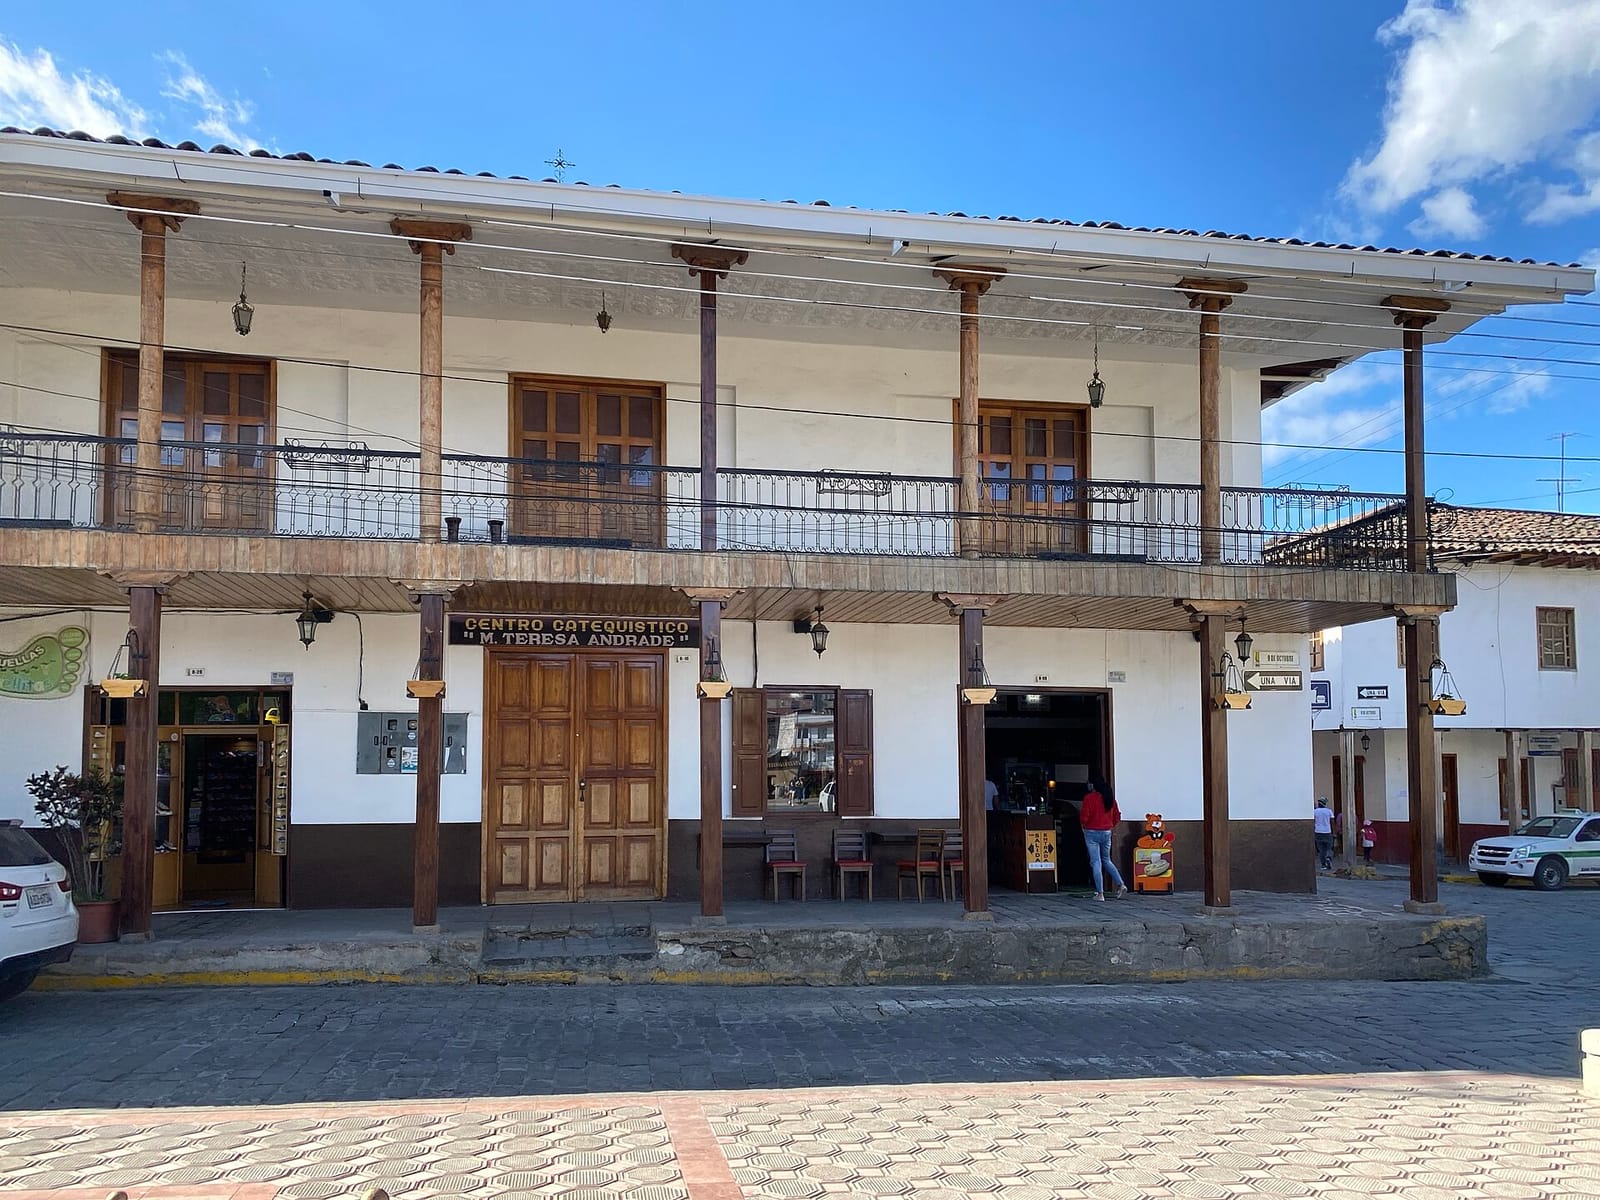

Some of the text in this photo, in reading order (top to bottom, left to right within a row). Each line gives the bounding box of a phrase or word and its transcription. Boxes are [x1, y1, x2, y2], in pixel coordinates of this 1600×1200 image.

[465, 618, 689, 634] CENTRO CATEQUISTICO
[502, 632, 580, 646] TERESA
[587, 634, 675, 647] ANDRADE
[1260, 676, 1297, 685] UNA VIA
